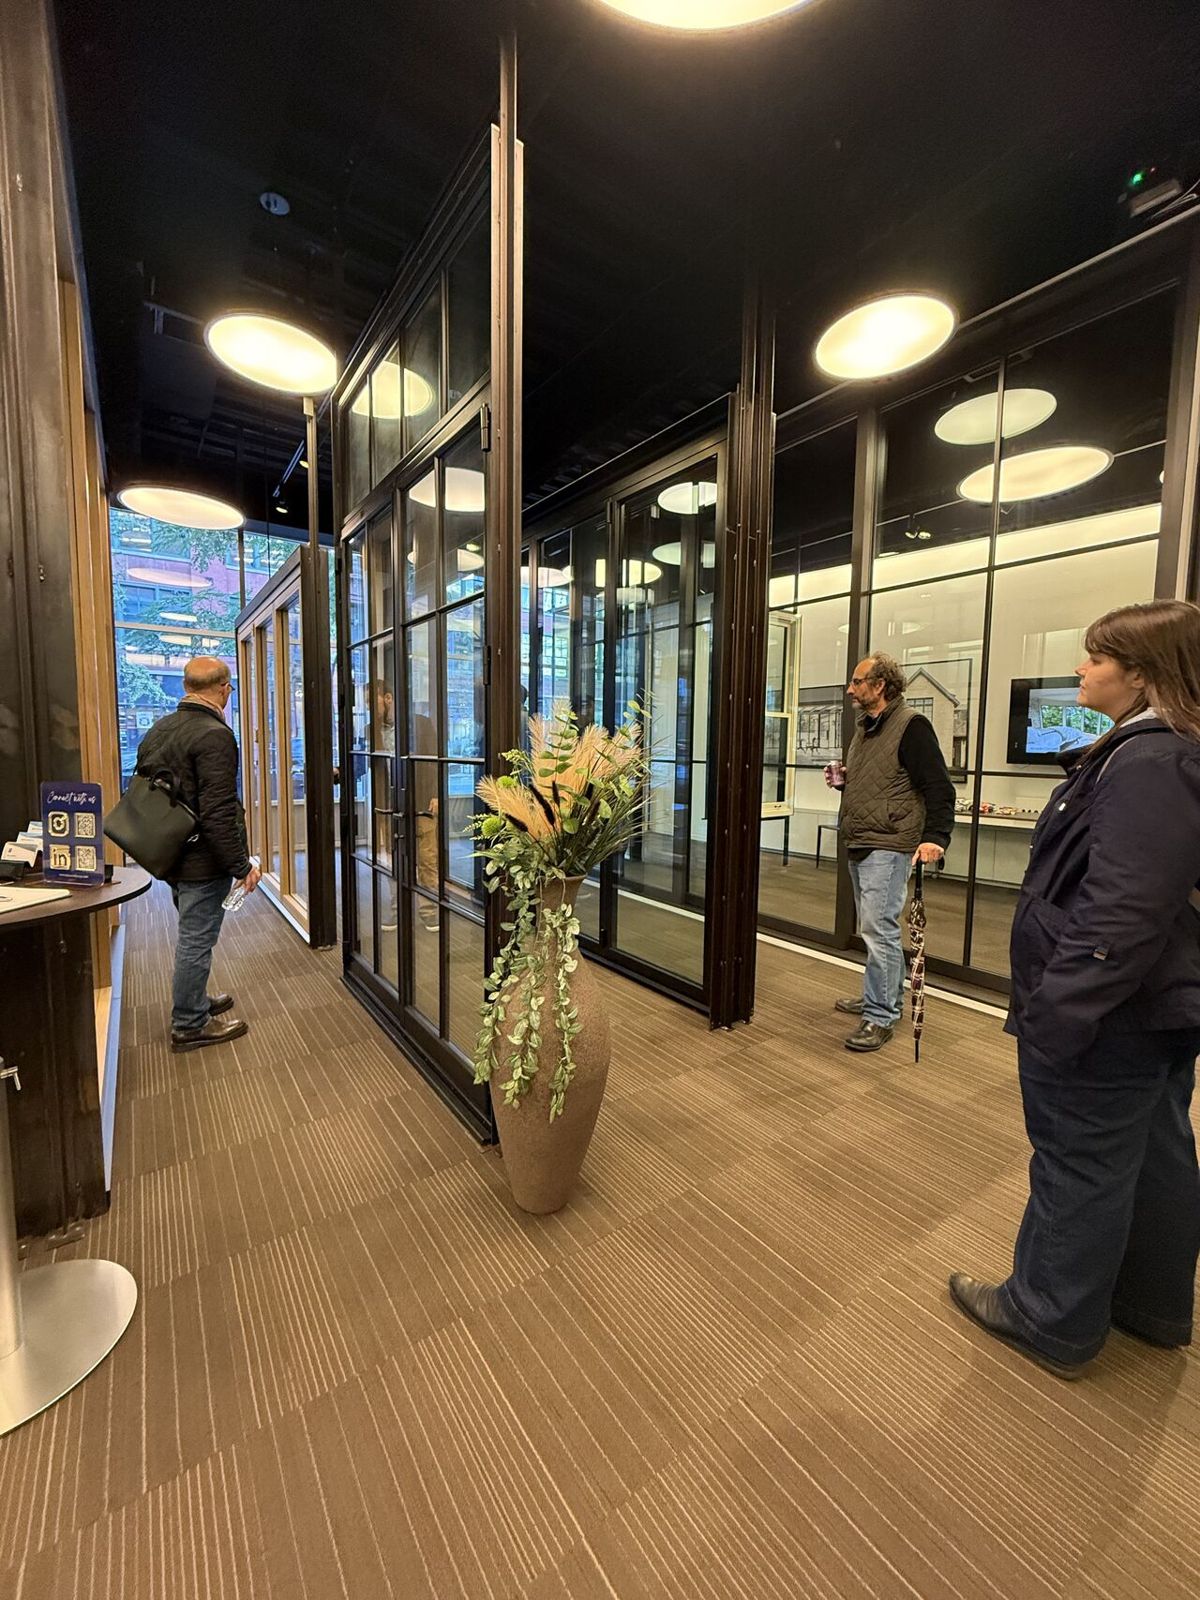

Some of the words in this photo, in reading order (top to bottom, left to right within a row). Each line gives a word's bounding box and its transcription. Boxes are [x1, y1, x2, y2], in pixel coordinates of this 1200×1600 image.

[73, 792, 87, 805] with
[88, 796, 96, 805] us
[53, 848, 67, 866] in
